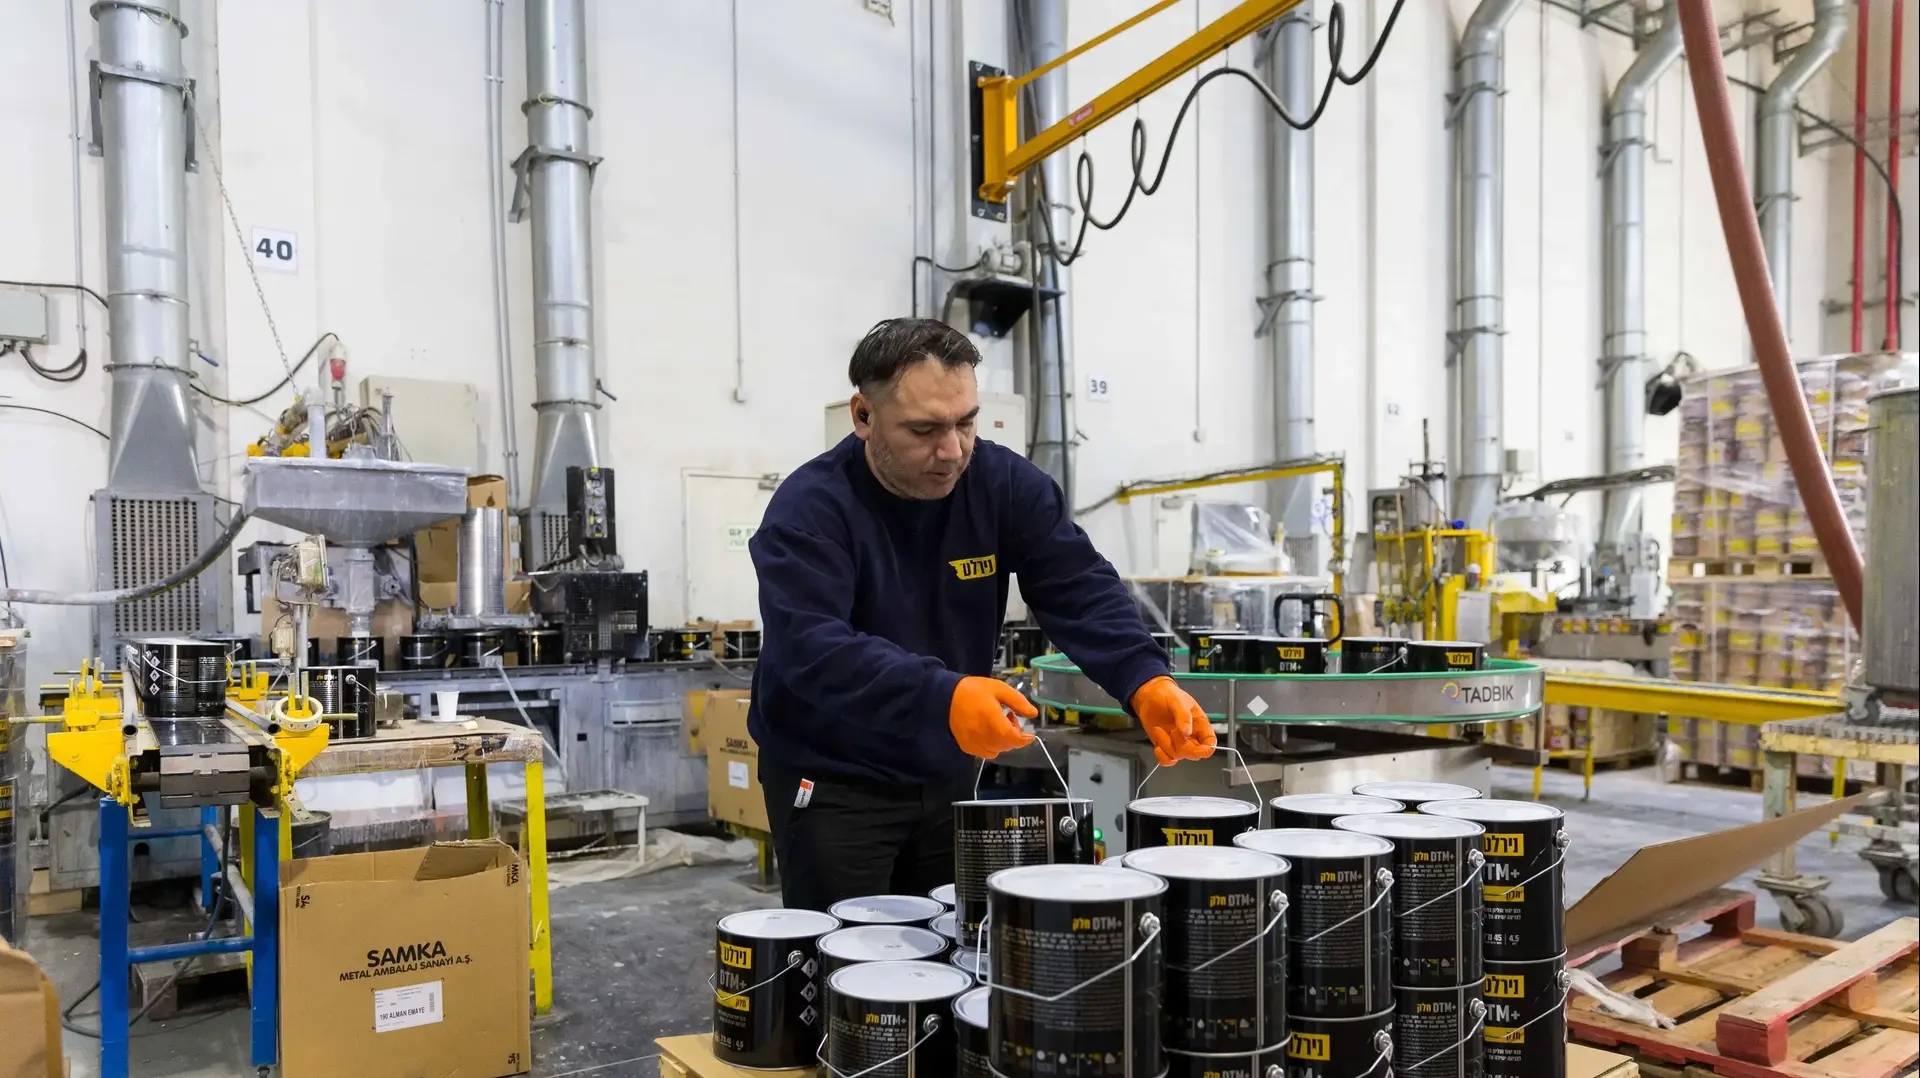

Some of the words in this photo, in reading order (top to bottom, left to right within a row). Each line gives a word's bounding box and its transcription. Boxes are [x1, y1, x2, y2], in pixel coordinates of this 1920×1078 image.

[256, 238, 292, 260] 40
[1091, 379, 1107, 394] 39
[960, 559, 993, 577] נירלט
[1280, 661, 1302, 671] DTM+
[1461, 685, 1514, 703] TADBIK
[1020, 816, 1045, 828] DTM+
[1414, 852, 1429, 863] חלק
[1430, 851, 1455, 862] DTM+
[1320, 872, 1336, 883] חלק
[1337, 870, 1363, 882] DTM+
[1484, 863, 1520, 881] TM+
[1209, 896, 1227, 908] חלק
[1228, 894, 1255, 906] DTM+
[1072, 918, 1091, 932] חלק
[1092, 917, 1122, 930] DTM+
[1493, 934, 1503, 942] 45
[1509, 934, 1520, 942] 4.5
[367, 940, 446, 967] SAMKA
[724, 946, 748, 965] נירלט
[340, 970, 371, 981] METAL
[373, 963, 417, 977] AMBALAJ
[420, 955, 453, 970] SANAYİ
[720, 968, 747, 990] DTM+
[389, 1010, 408, 1019] ALMAN
[408, 1007, 425, 1016] EMAYE
[1416, 1003, 1431, 1013] חלק
[1433, 1002, 1457, 1013] DTM+
[1485, 1004, 1520, 1022] TM+
[880, 1014, 907, 1025] DTM+
